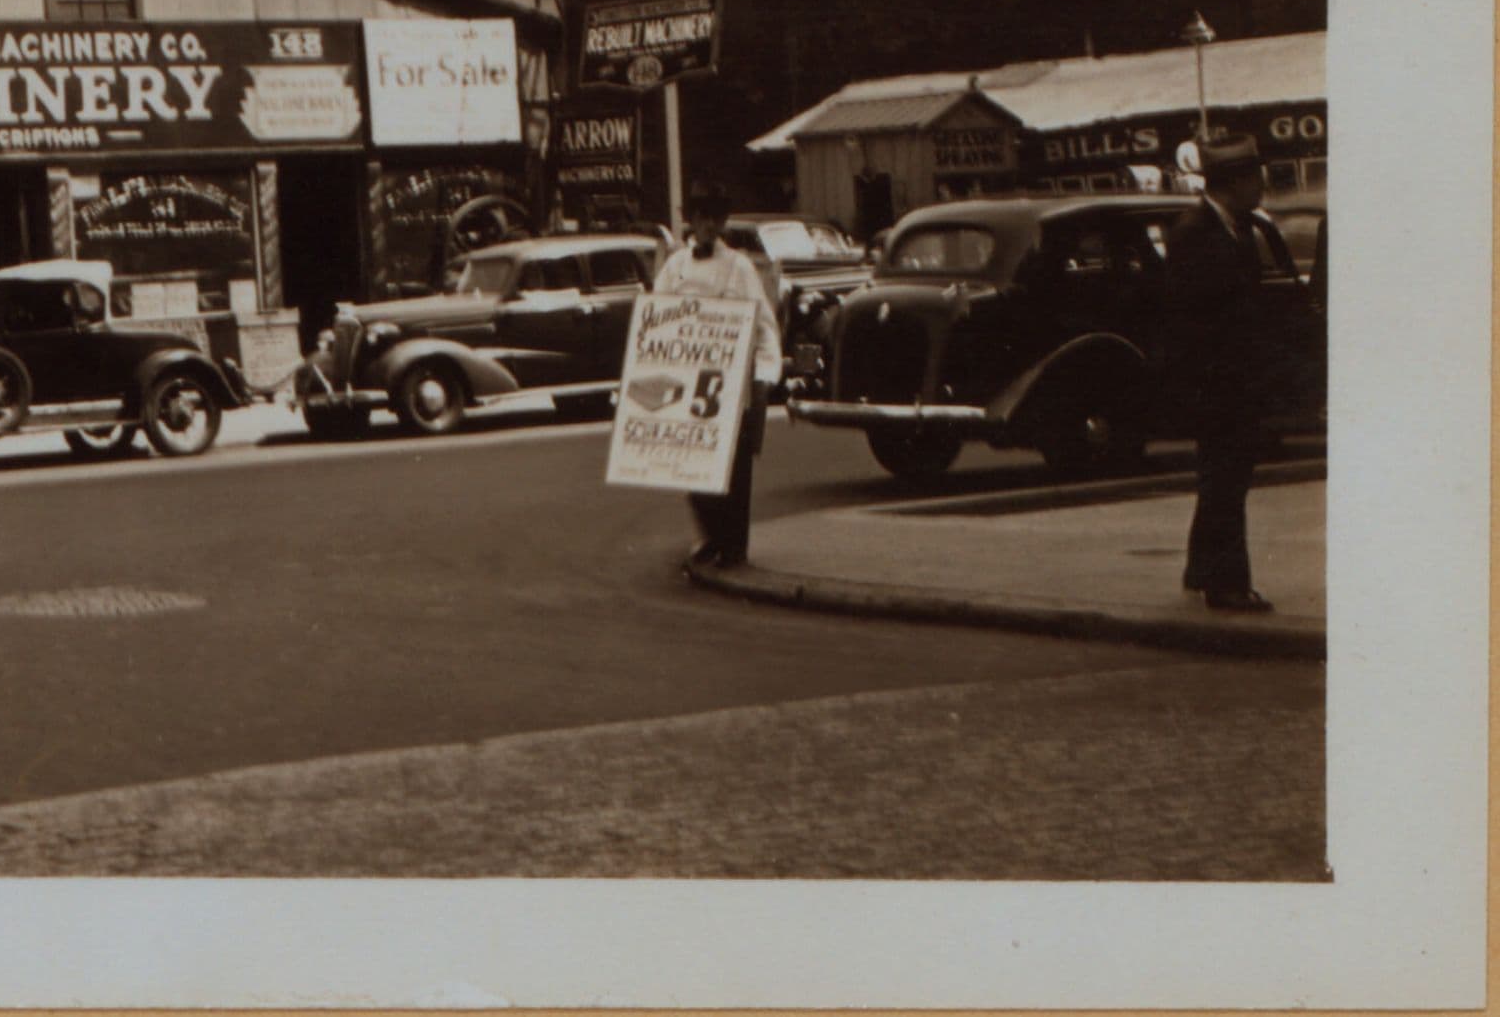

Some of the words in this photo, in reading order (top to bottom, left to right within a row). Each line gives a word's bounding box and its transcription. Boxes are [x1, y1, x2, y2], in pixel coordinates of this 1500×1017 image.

[160, 31, 207, 62] CO.
[378, 51, 430, 89] For
[436, 51, 509, 89] Sale
[561, 116, 633, 152] ARROW
[1044, 127, 1160, 162] BILL'S
[636, 338, 735, 369] SANDWICH
